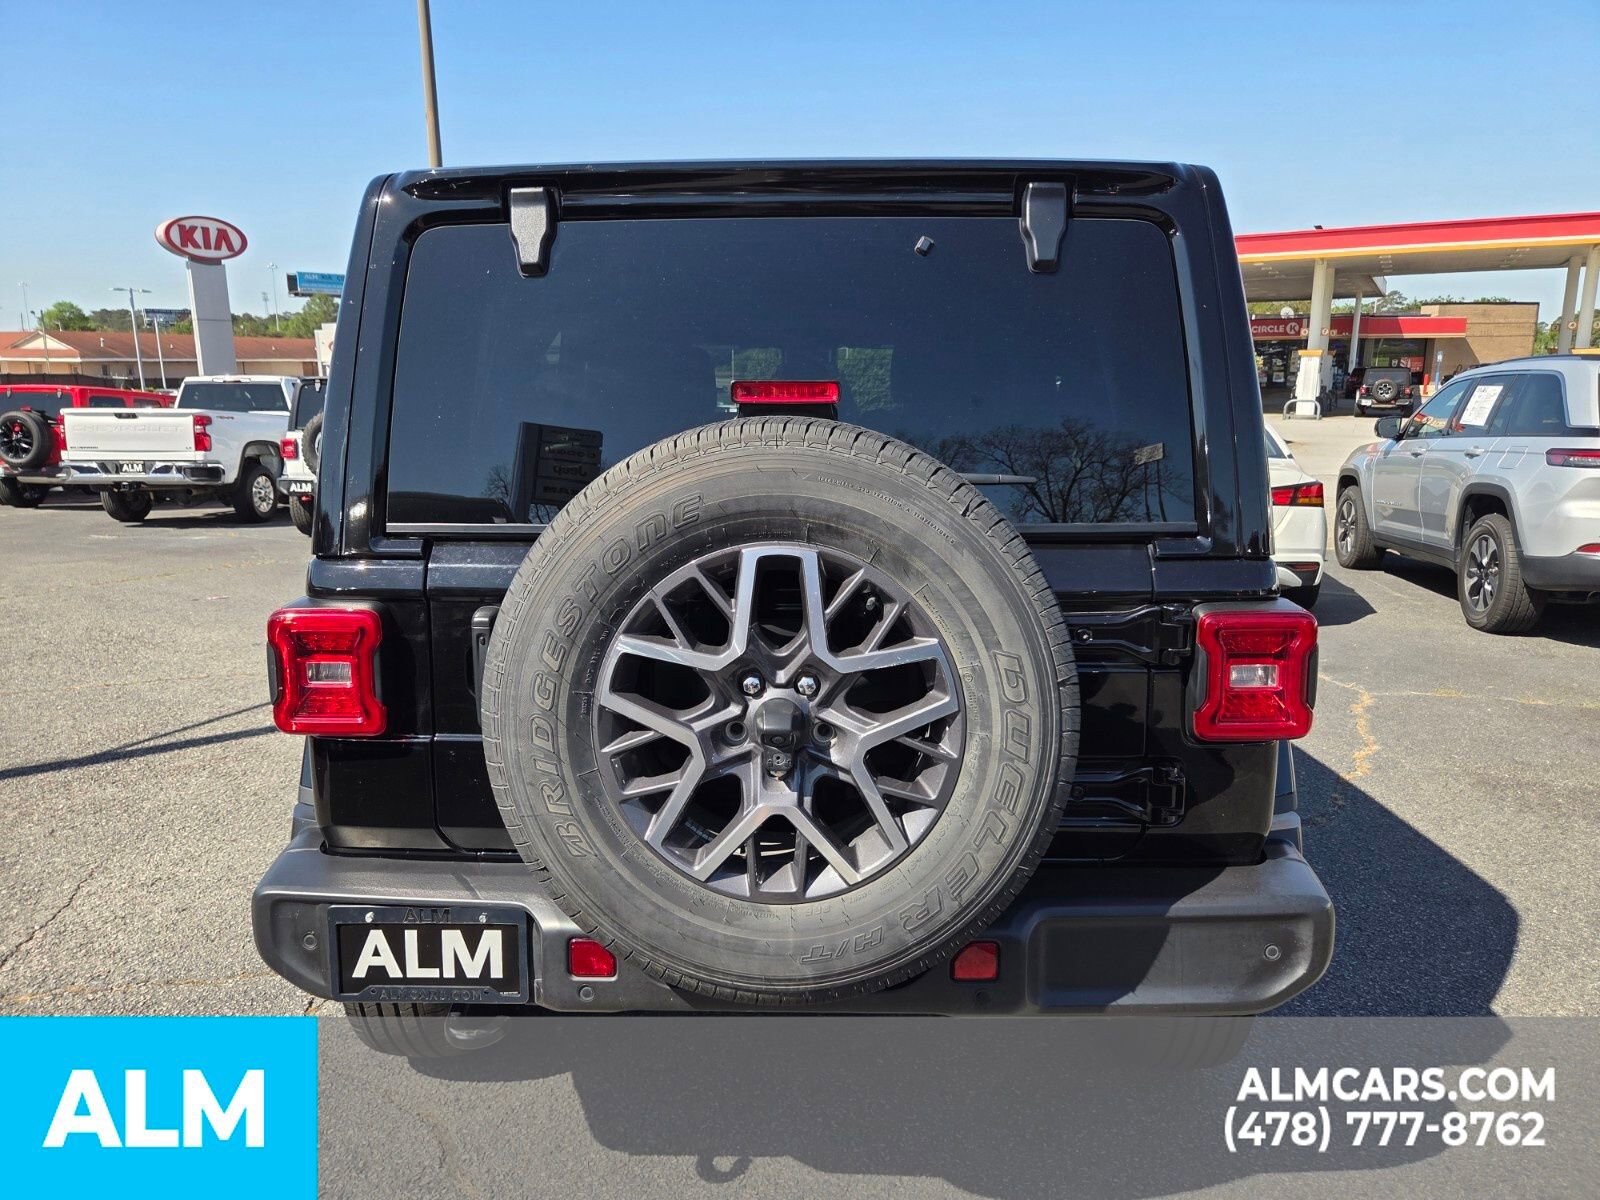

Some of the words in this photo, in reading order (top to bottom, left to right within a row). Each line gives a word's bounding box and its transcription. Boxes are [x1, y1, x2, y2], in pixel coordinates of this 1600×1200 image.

[177, 224, 236, 253] KIA
[1252, 325, 1285, 334] CIRCLE
[1288, 323, 1299, 334] K
[122, 463, 144, 473] ALM
[290, 482, 312, 493] ALM
[529, 494, 705, 859] BRIDGESTONE
[899, 650, 1032, 932] DUELER
[403, 907, 450, 924] ALM
[351, 929, 504, 979] ALM
[801, 926, 884, 964] H/T
